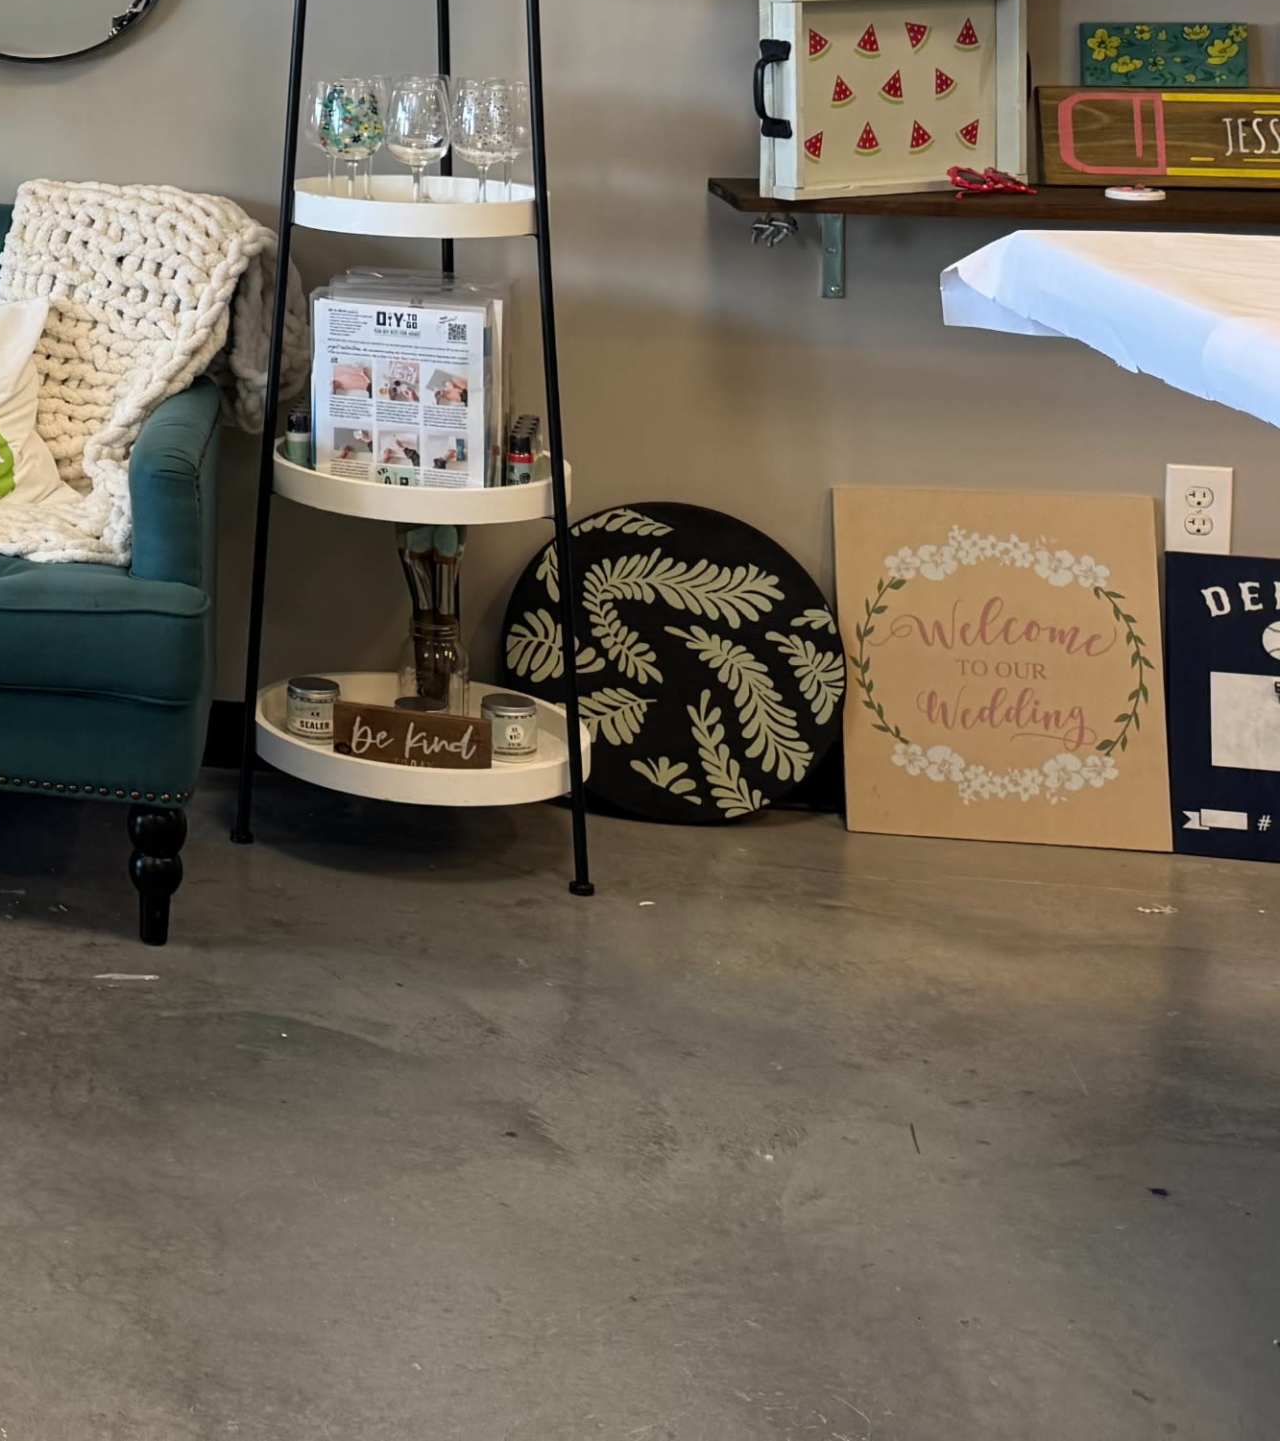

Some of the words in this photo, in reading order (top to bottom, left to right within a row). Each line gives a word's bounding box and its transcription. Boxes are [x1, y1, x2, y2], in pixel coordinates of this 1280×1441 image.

[868, 596, 1118, 658] Welcome
[956, 658, 989, 678] TO
[994, 661, 1048, 682] OUR
[300, 720, 330, 731] SEALER
[351, 716, 393, 754] be
[405, 722, 476, 760] kind
[916, 685, 1098, 752] Wedding
